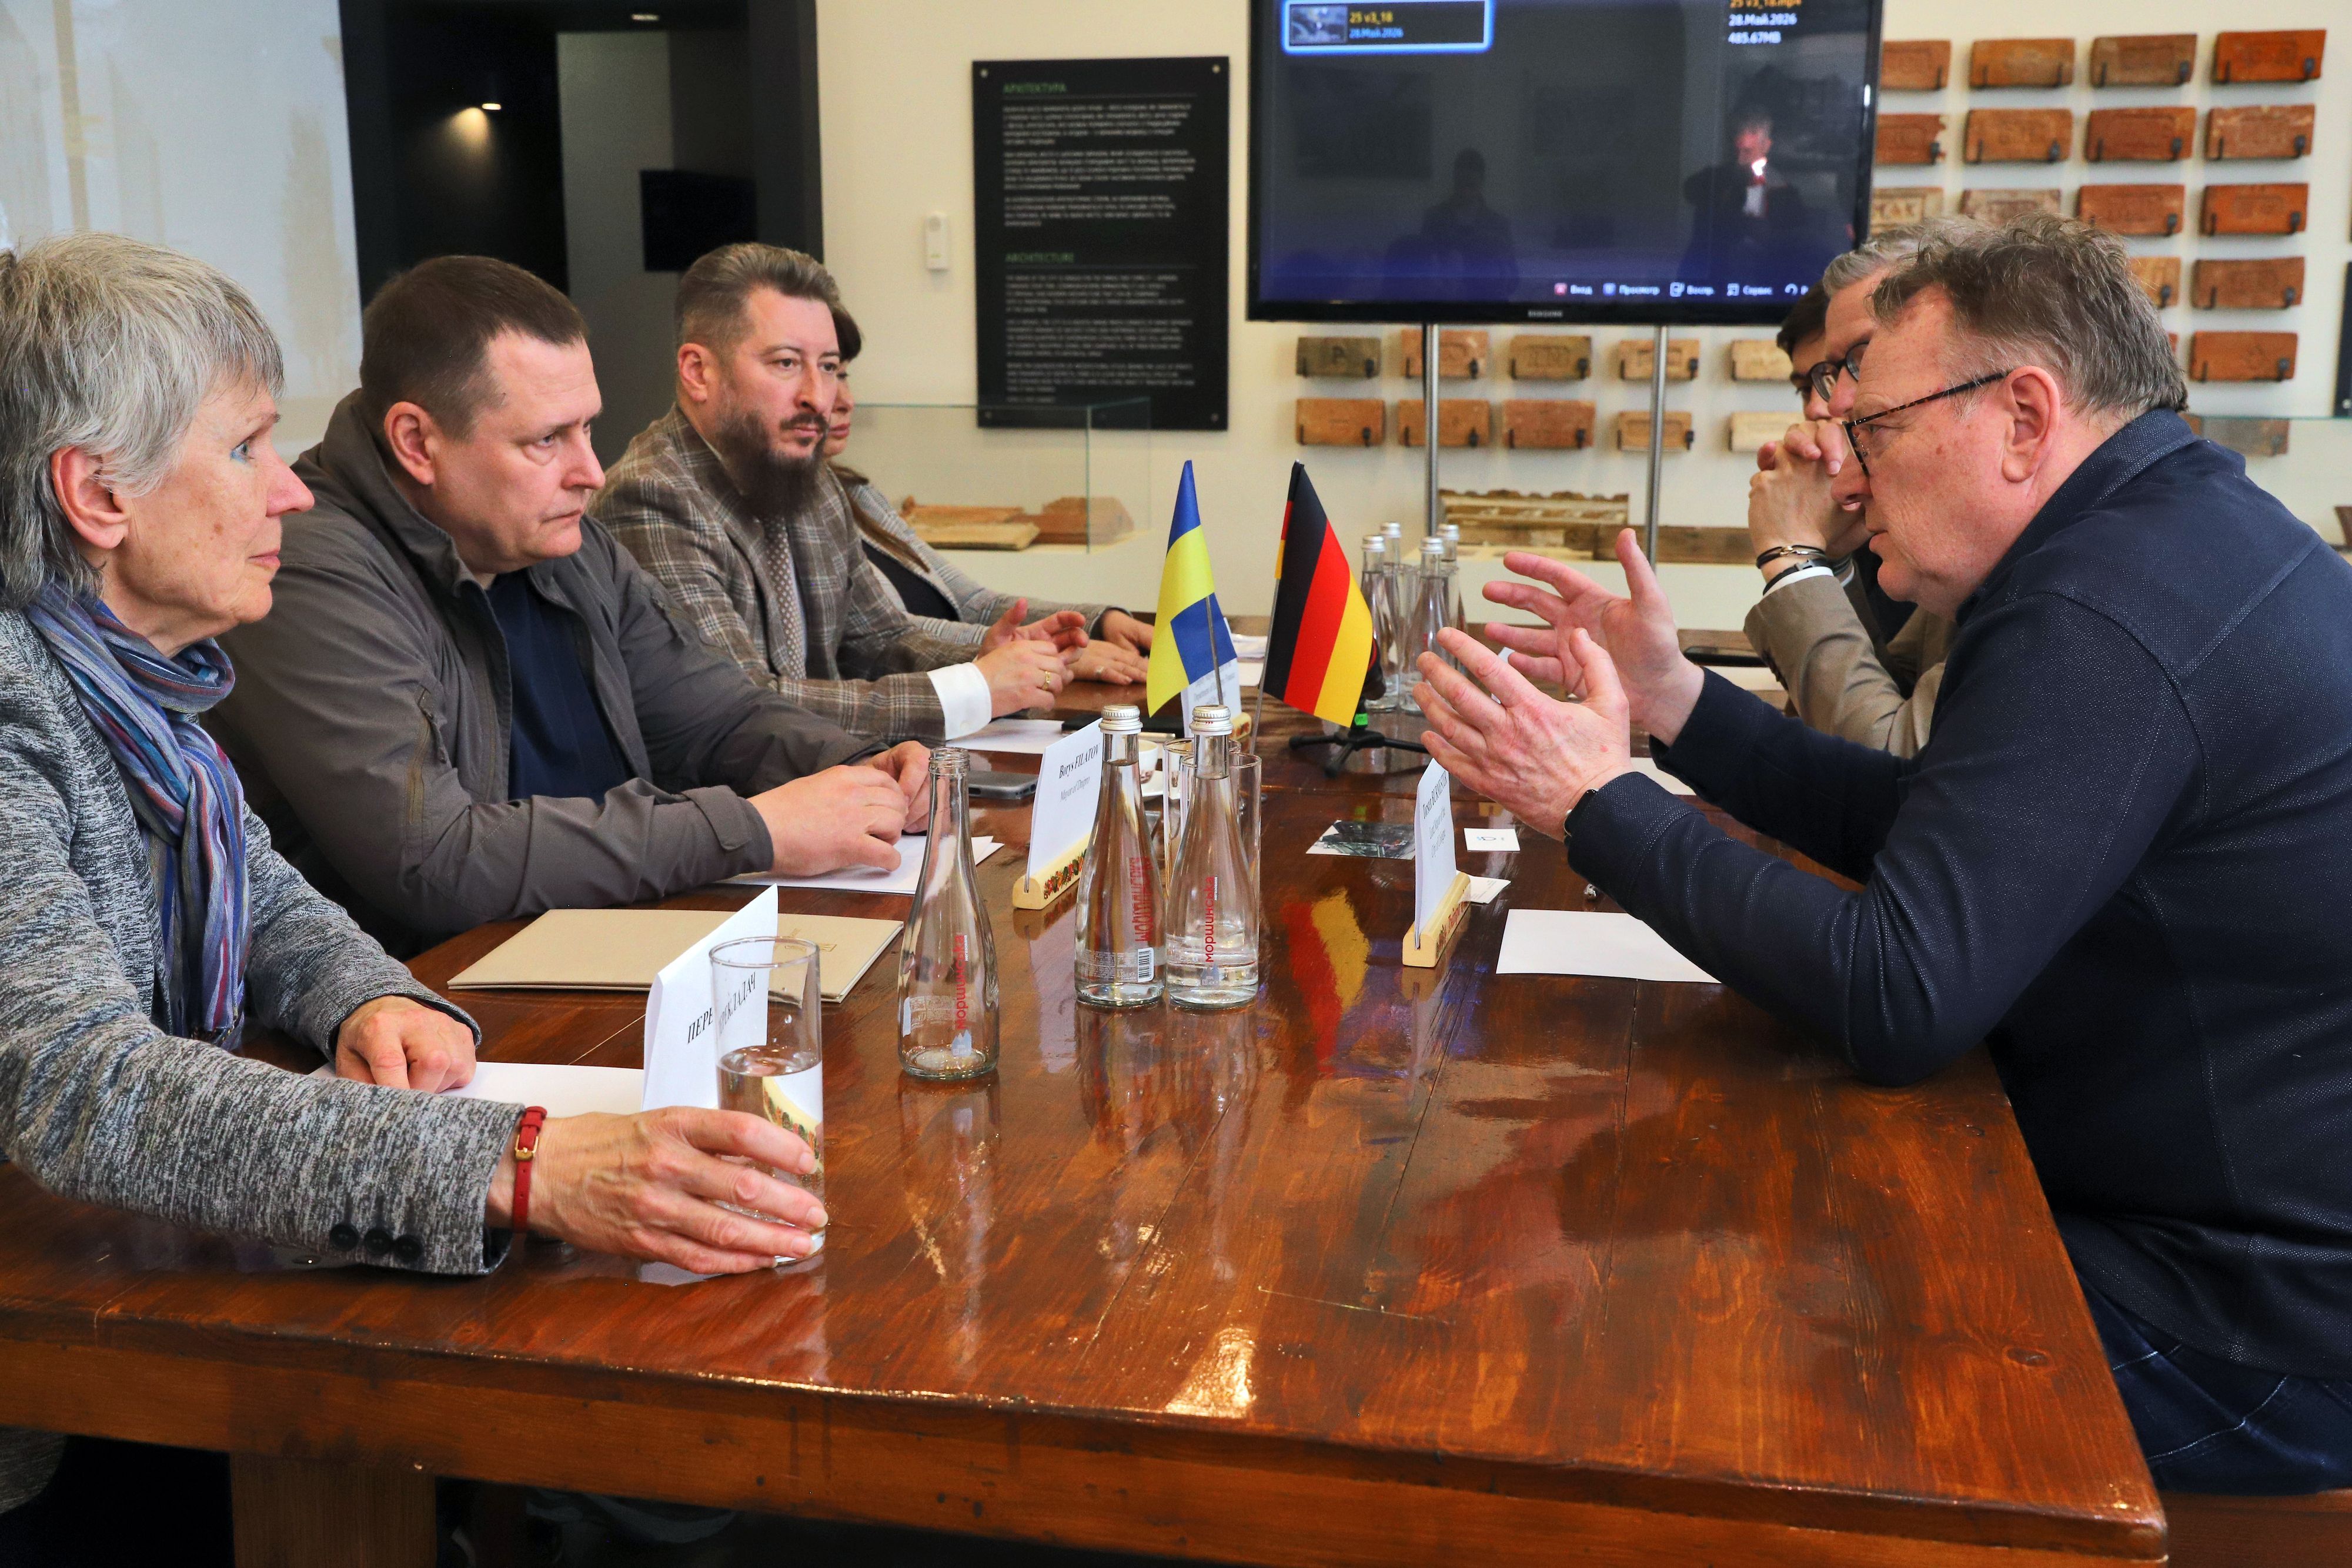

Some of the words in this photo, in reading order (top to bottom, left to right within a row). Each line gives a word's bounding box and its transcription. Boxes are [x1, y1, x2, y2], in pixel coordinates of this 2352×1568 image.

[1059, 762, 1074, 779] Borys
[1074, 743, 1100, 770] FILATOV
[1060, 787, 1072, 801] Mayor
[1204, 876, 1217, 962] моршинська
[953, 934, 968, 1030] моршинська
